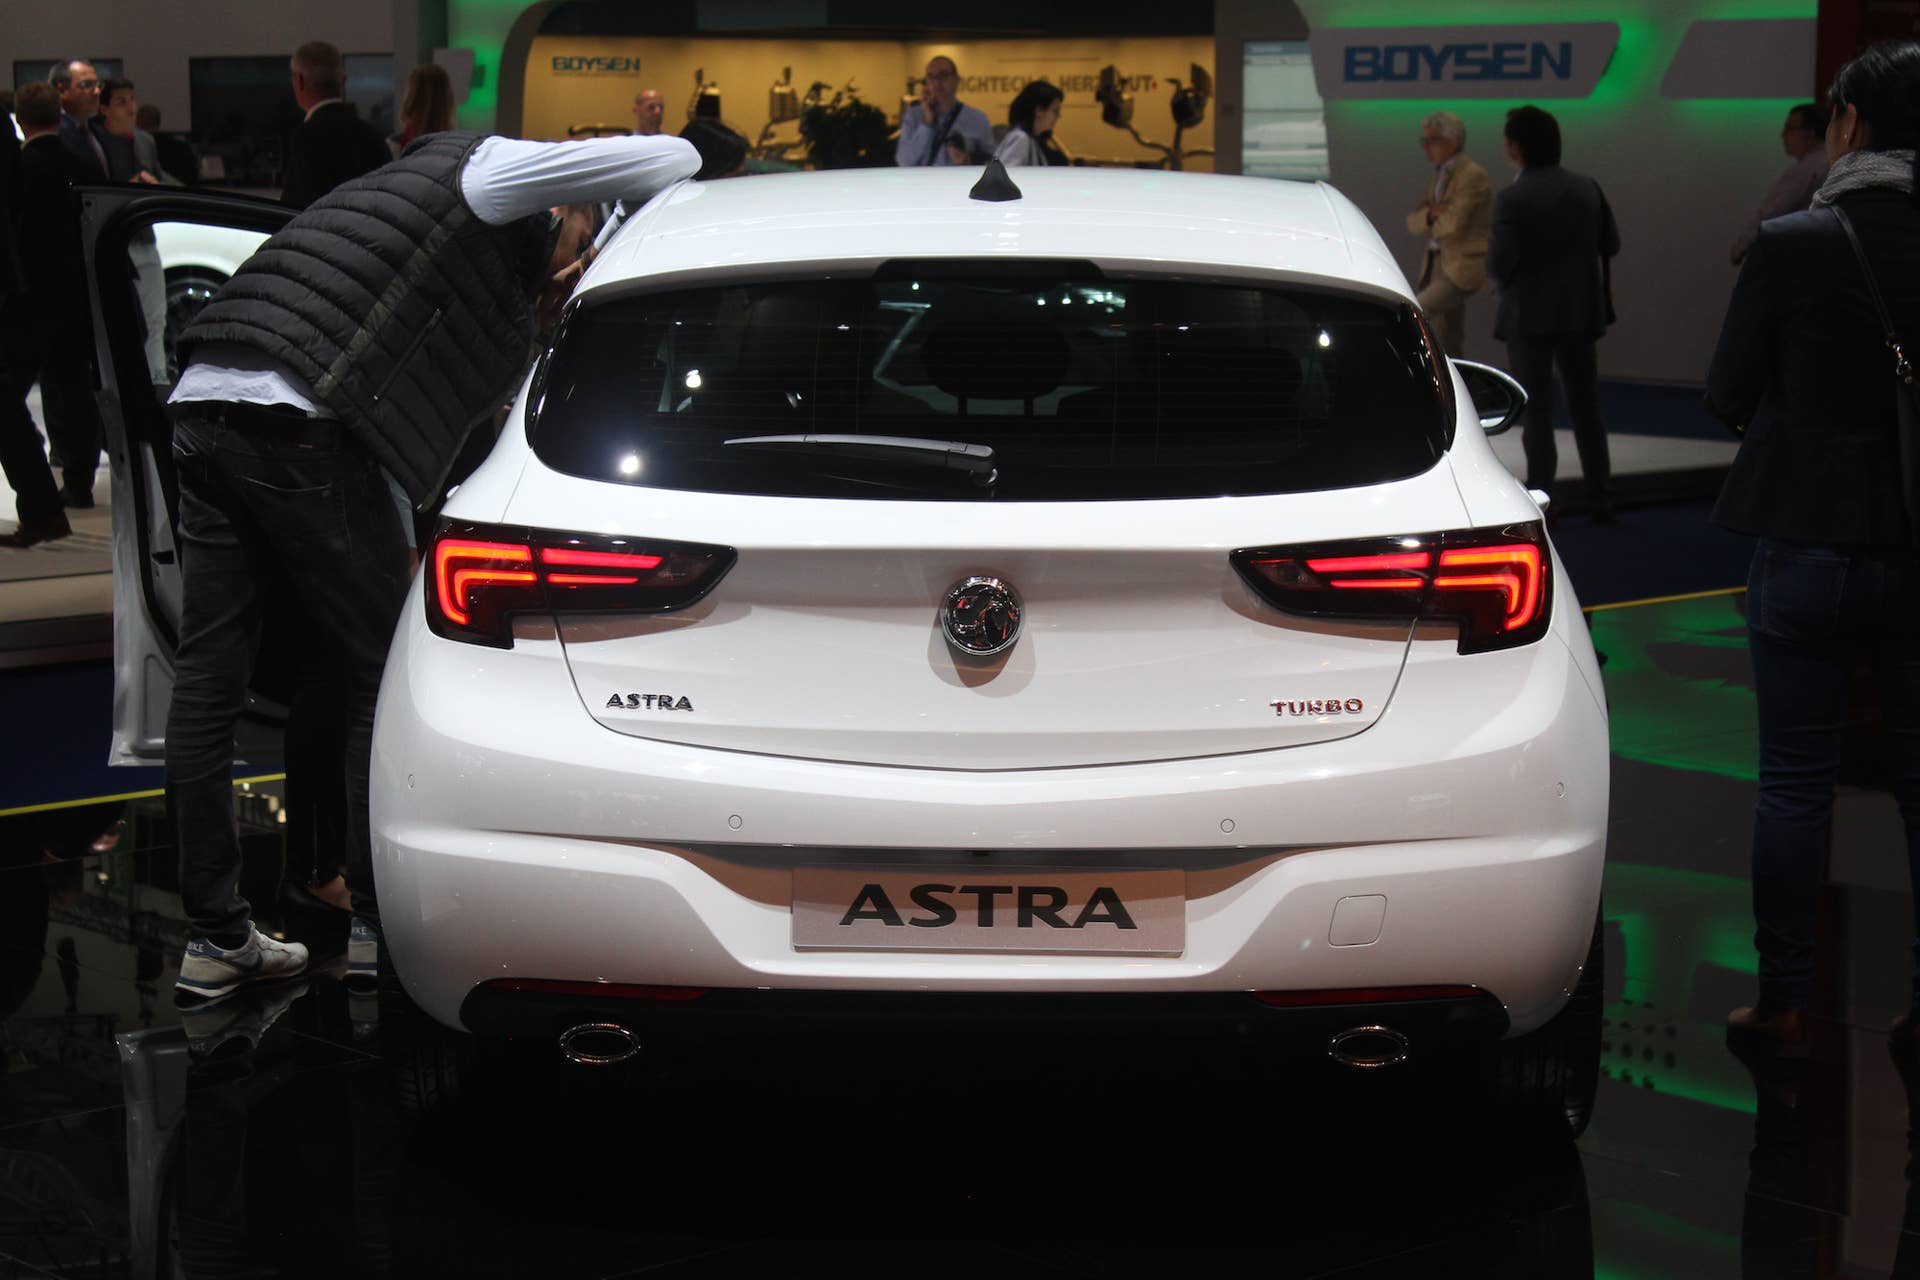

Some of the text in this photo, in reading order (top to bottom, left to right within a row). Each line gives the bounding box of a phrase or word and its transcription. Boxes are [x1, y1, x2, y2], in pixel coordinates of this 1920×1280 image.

[552, 56, 640, 71] BOYSEN
[1344, 42, 1572, 82] BOYSEN
[606, 693, 694, 711] ASTRA
[1270, 698, 1363, 716] TURBO
[839, 884, 1138, 930] ASTRA
